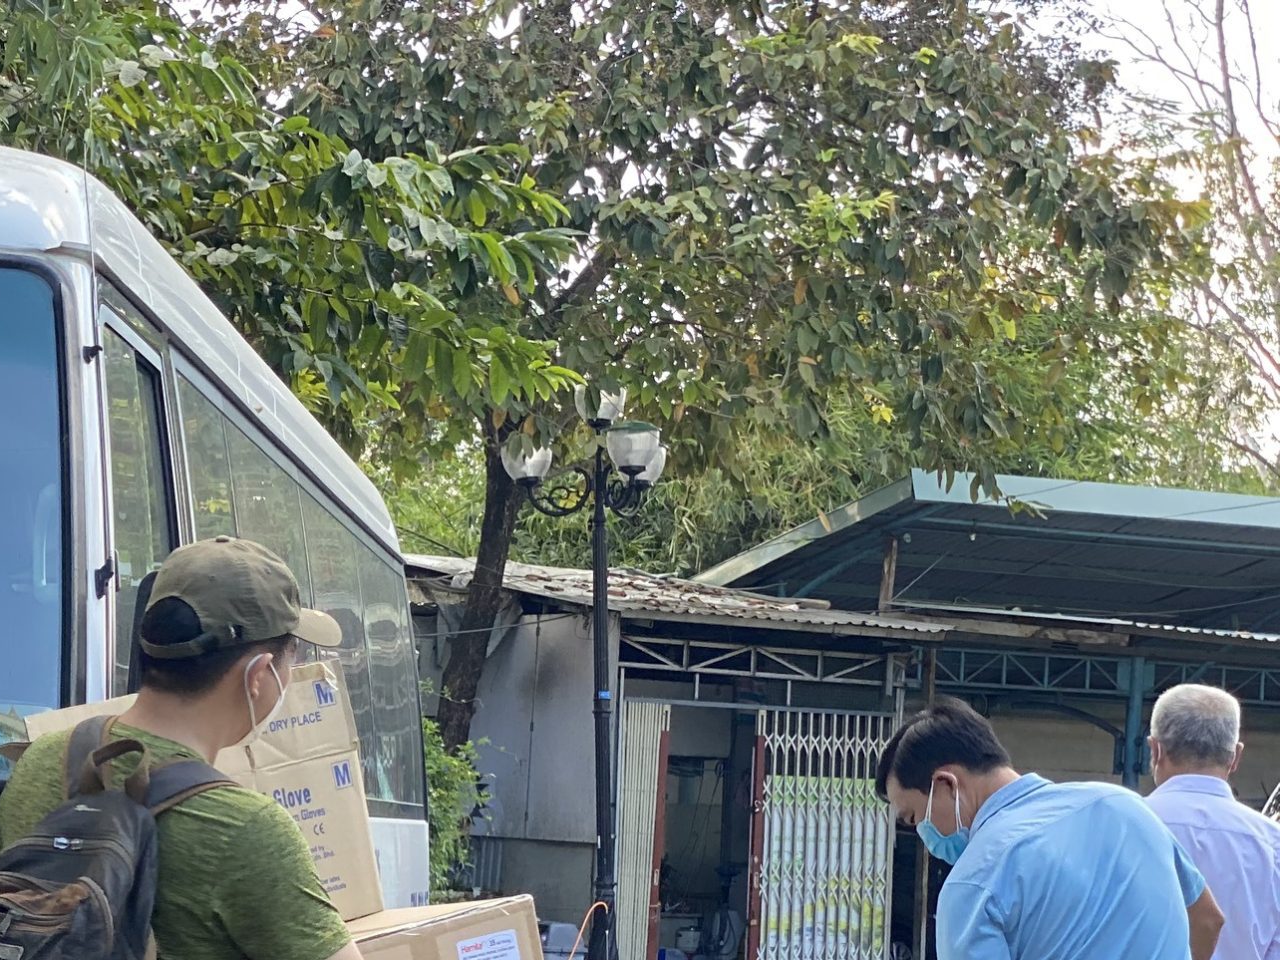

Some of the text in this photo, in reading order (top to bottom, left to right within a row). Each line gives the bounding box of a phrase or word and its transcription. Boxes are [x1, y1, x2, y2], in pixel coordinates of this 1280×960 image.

[316, 683, 334, 706] M
[270, 711, 322, 733] DRY PLACE
[333, 762, 351, 787] M
[273, 787, 312, 809] Glove
[300, 808, 326, 821] Gloves
